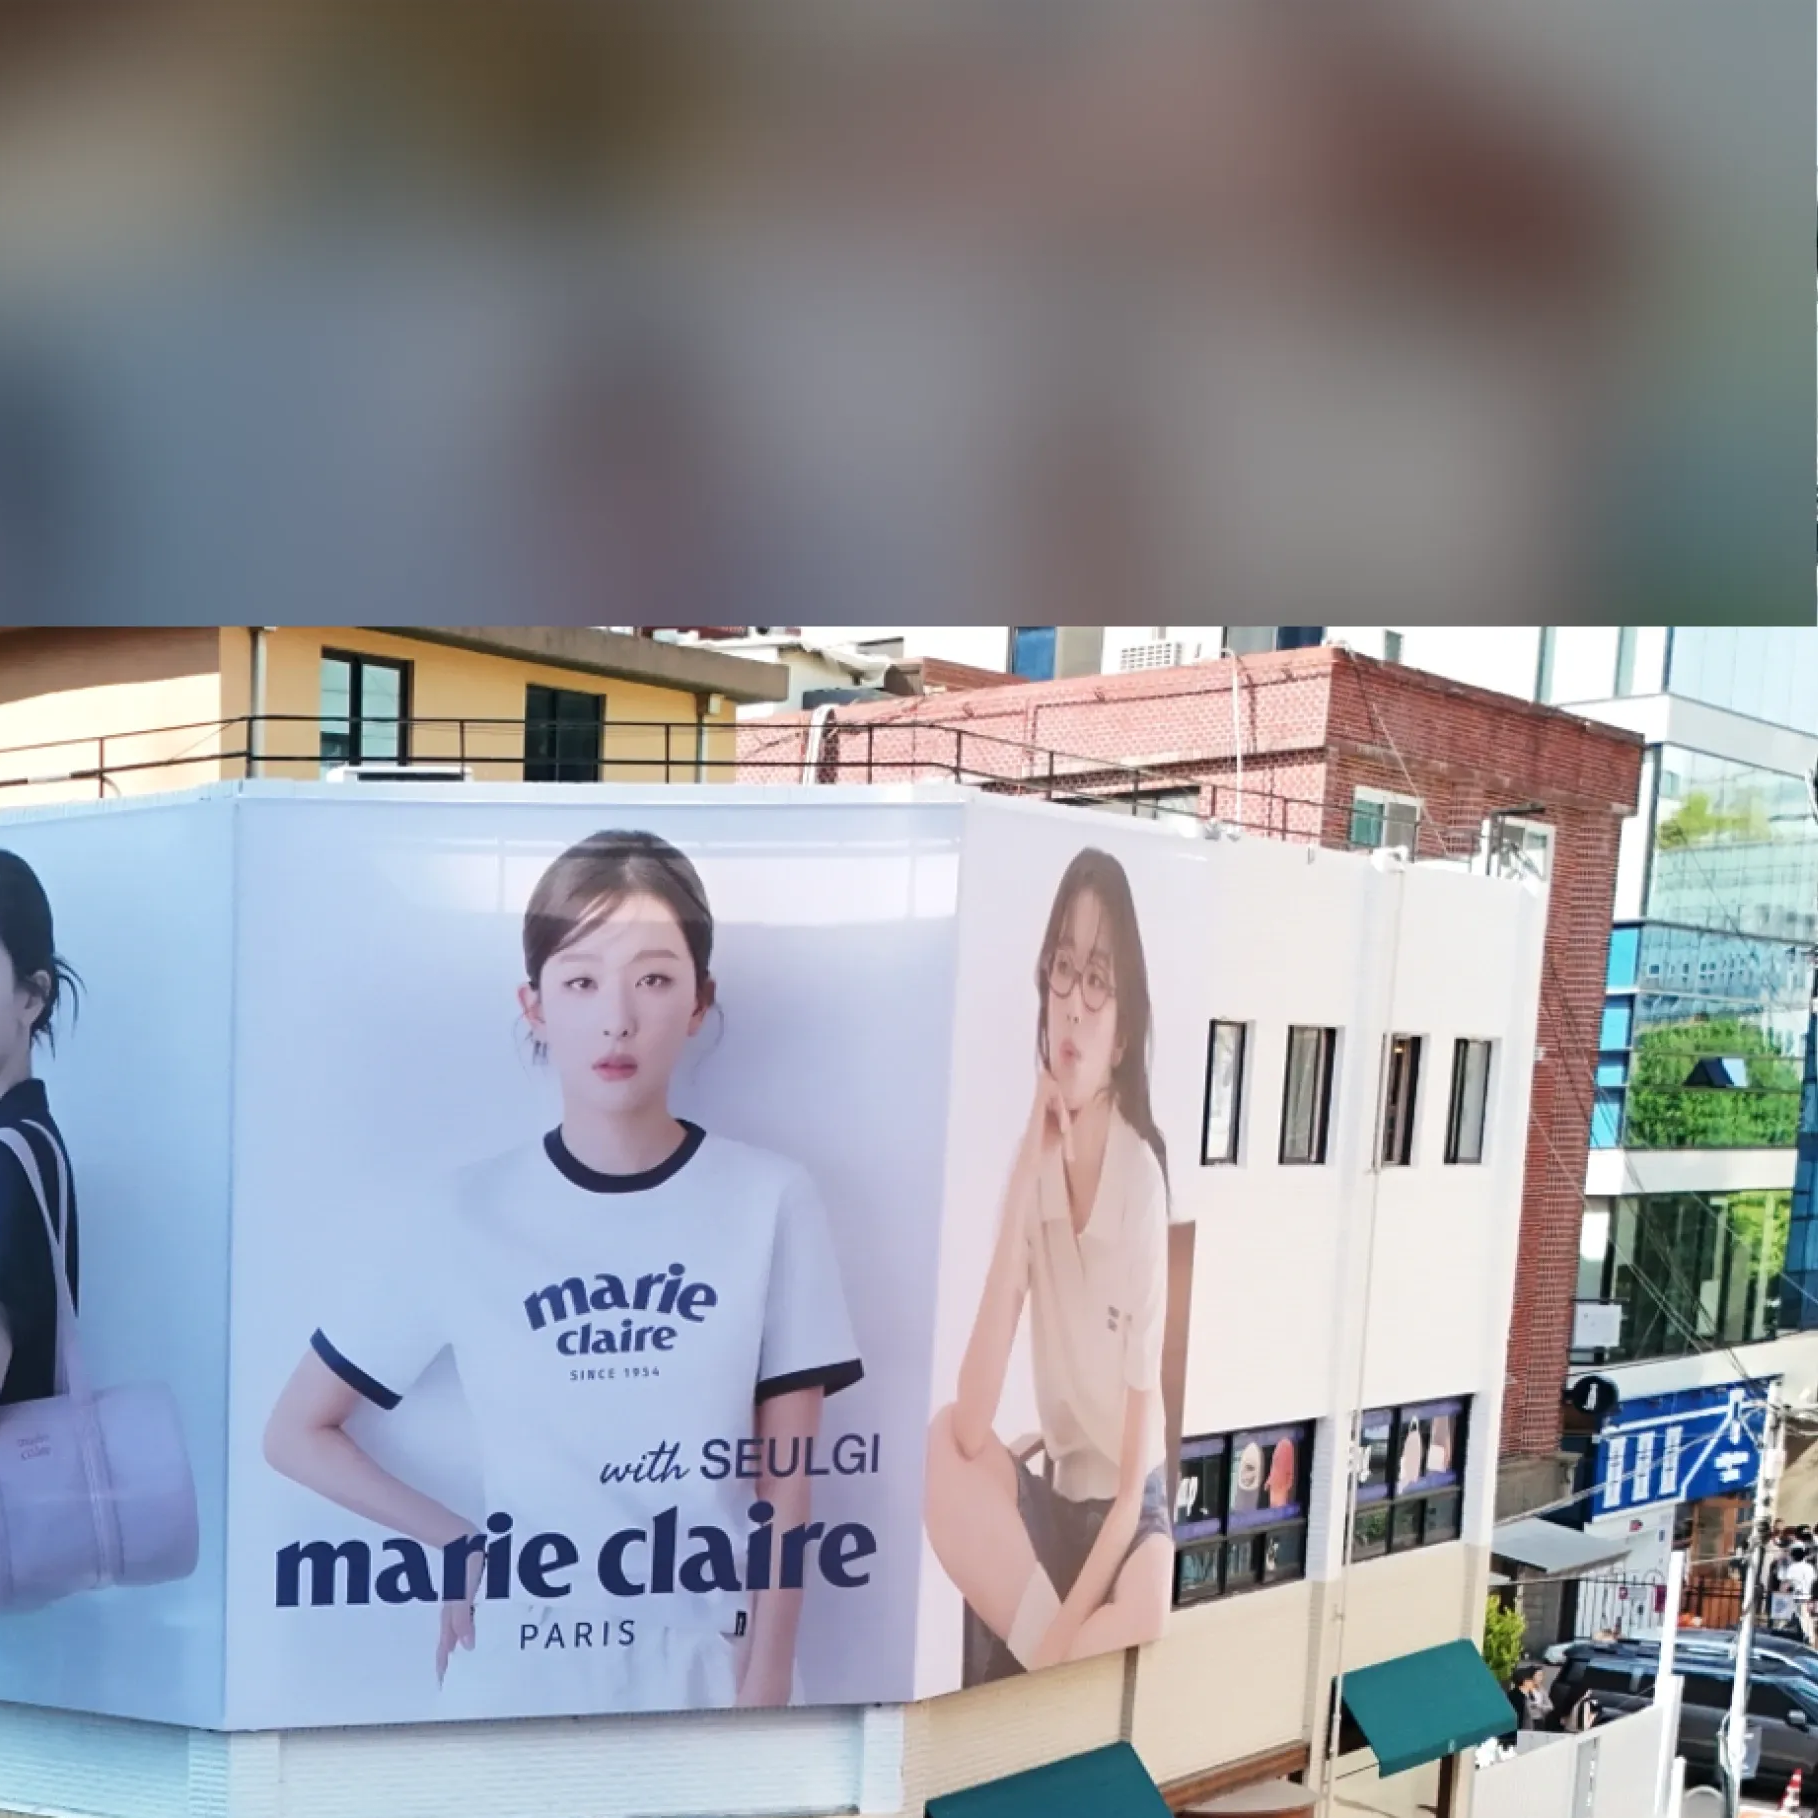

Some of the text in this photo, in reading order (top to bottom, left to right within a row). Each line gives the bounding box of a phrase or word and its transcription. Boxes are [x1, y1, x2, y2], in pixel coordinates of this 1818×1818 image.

[523, 1262, 718, 1331] marie
[556, 1318, 678, 1356] claire
[569, 1367, 616, 1381] SINCE
[599, 1434, 880, 1484] with SEULGI
[275, 1500, 878, 1609] marie claire
[519, 1620, 636, 1650] PARIS
